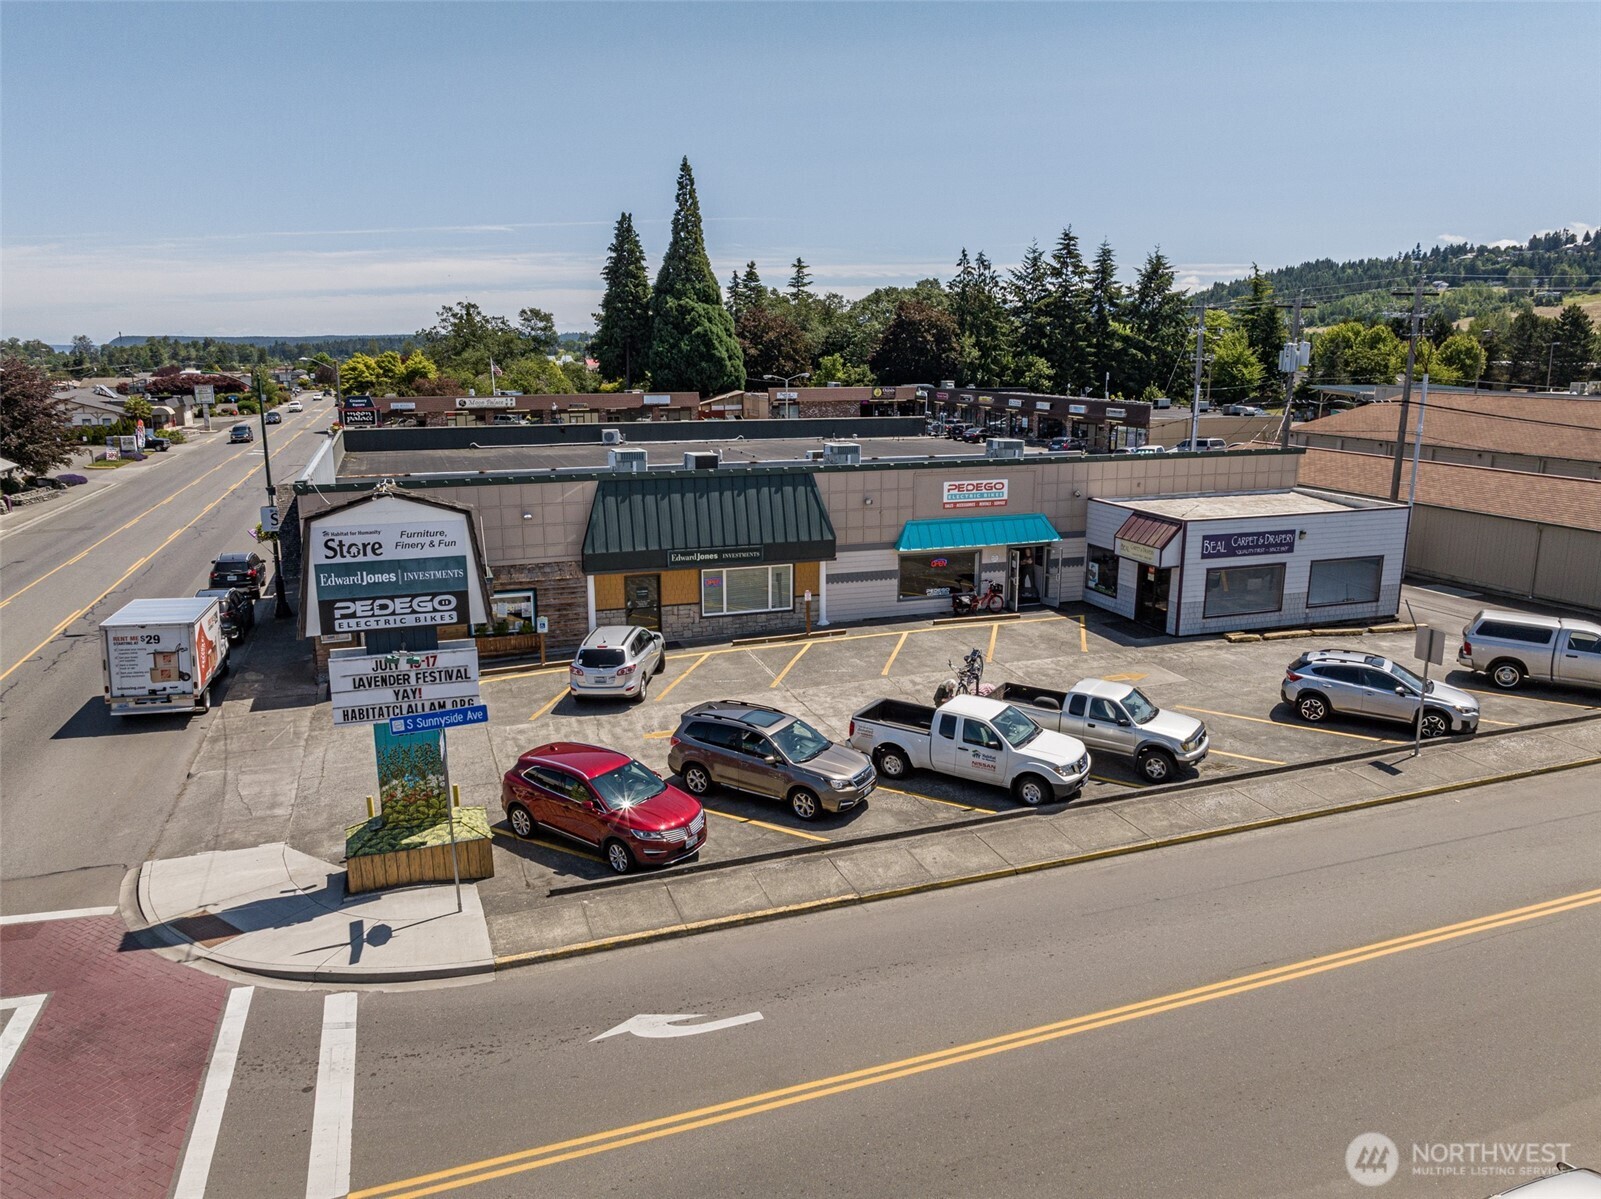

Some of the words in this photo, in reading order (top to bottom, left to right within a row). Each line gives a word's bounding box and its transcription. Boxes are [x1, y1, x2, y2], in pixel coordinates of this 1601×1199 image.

[947, 482, 1004, 493] PEDEGO
[400, 530, 448, 539] Furniture,
[323, 538, 383, 560] Store
[395, 541, 426, 550] Finery
[429, 540, 436, 548] &
[438, 540, 457, 548] Fun
[1203, 540, 1227, 554] BEAL
[1231, 536, 1258, 547] CARPET
[1264, 534, 1295, 544] DRAPERY
[403, 569, 464, 581] INVESTMENTS
[334, 594, 457, 619] PEDEGO
[338, 617, 407, 629] ELECTRIC
[415, 613, 454, 623] BIKES
[140, 634, 160, 645] $29
[352, 673, 411, 689] LAVENDER
[415, 668, 471, 684] FESTIVAL
[393, 687, 423, 701] YAY!
[406, 719, 414, 730] S
[416, 712, 463, 728] Sunnyside
[467, 709, 483, 721] Ave
